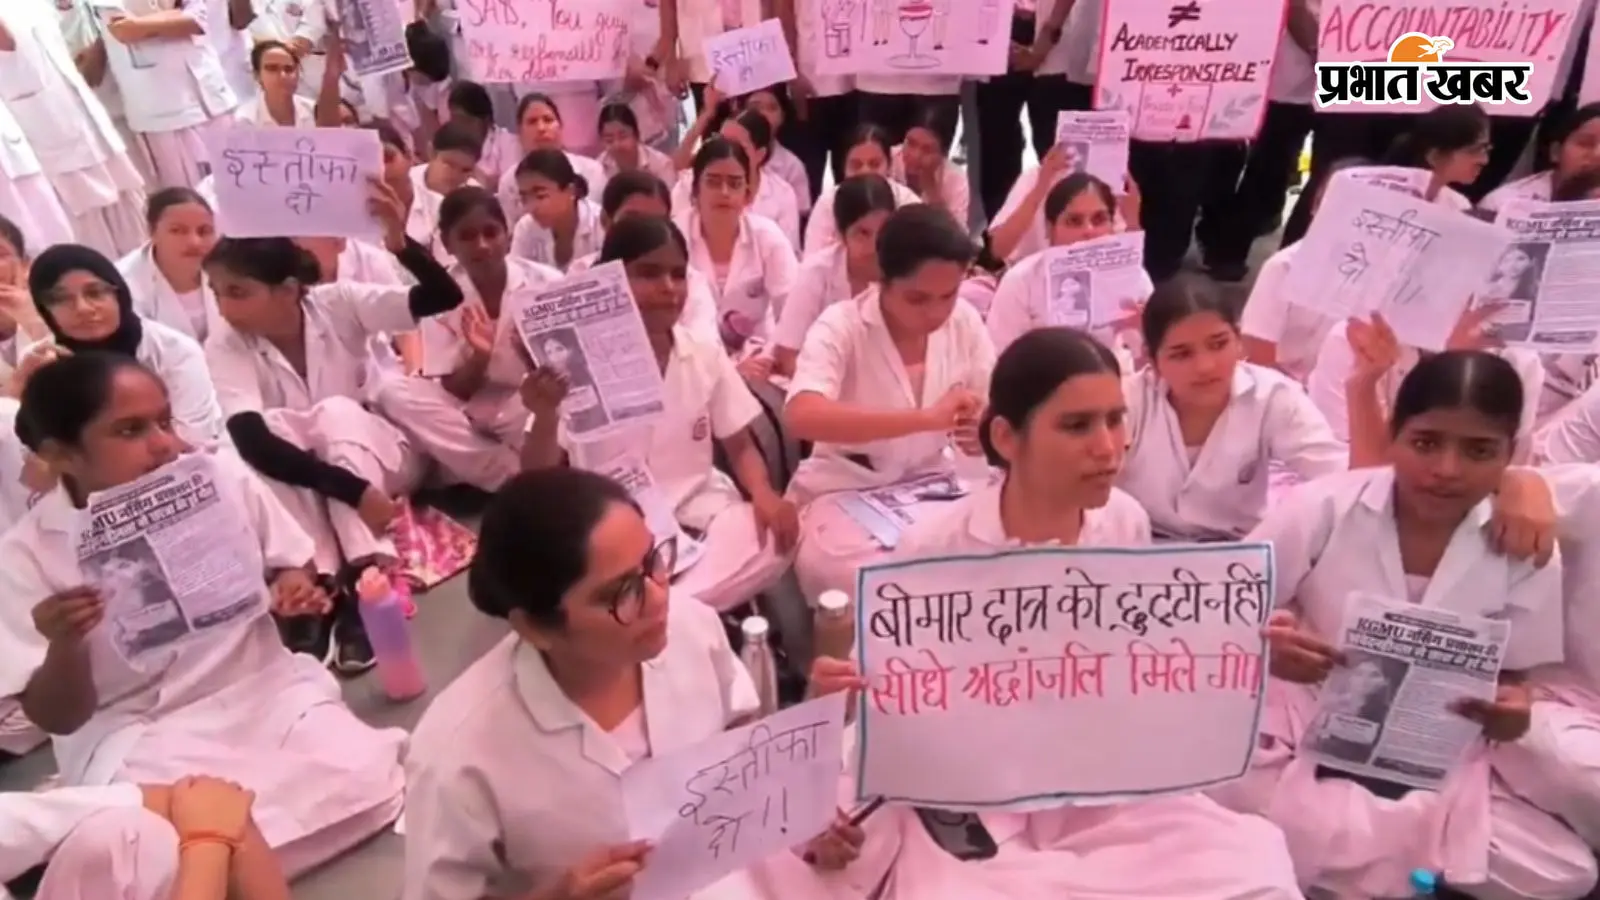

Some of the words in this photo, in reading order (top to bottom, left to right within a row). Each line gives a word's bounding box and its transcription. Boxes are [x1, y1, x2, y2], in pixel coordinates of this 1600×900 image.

[1110, 22, 1239, 52] ACADEMICALLY
[223, 136, 359, 190] इस्तीफा
[285, 183, 323, 215] दो
[870, 582, 974, 646] बीमार
[1056, 566, 1111, 631] को
[1203, 562, 1268, 627] नहीं
[1357, 617, 1404, 638] KGMU
[872, 648, 958, 716] सीधे
[678, 719, 831, 826] इस्तीफा
